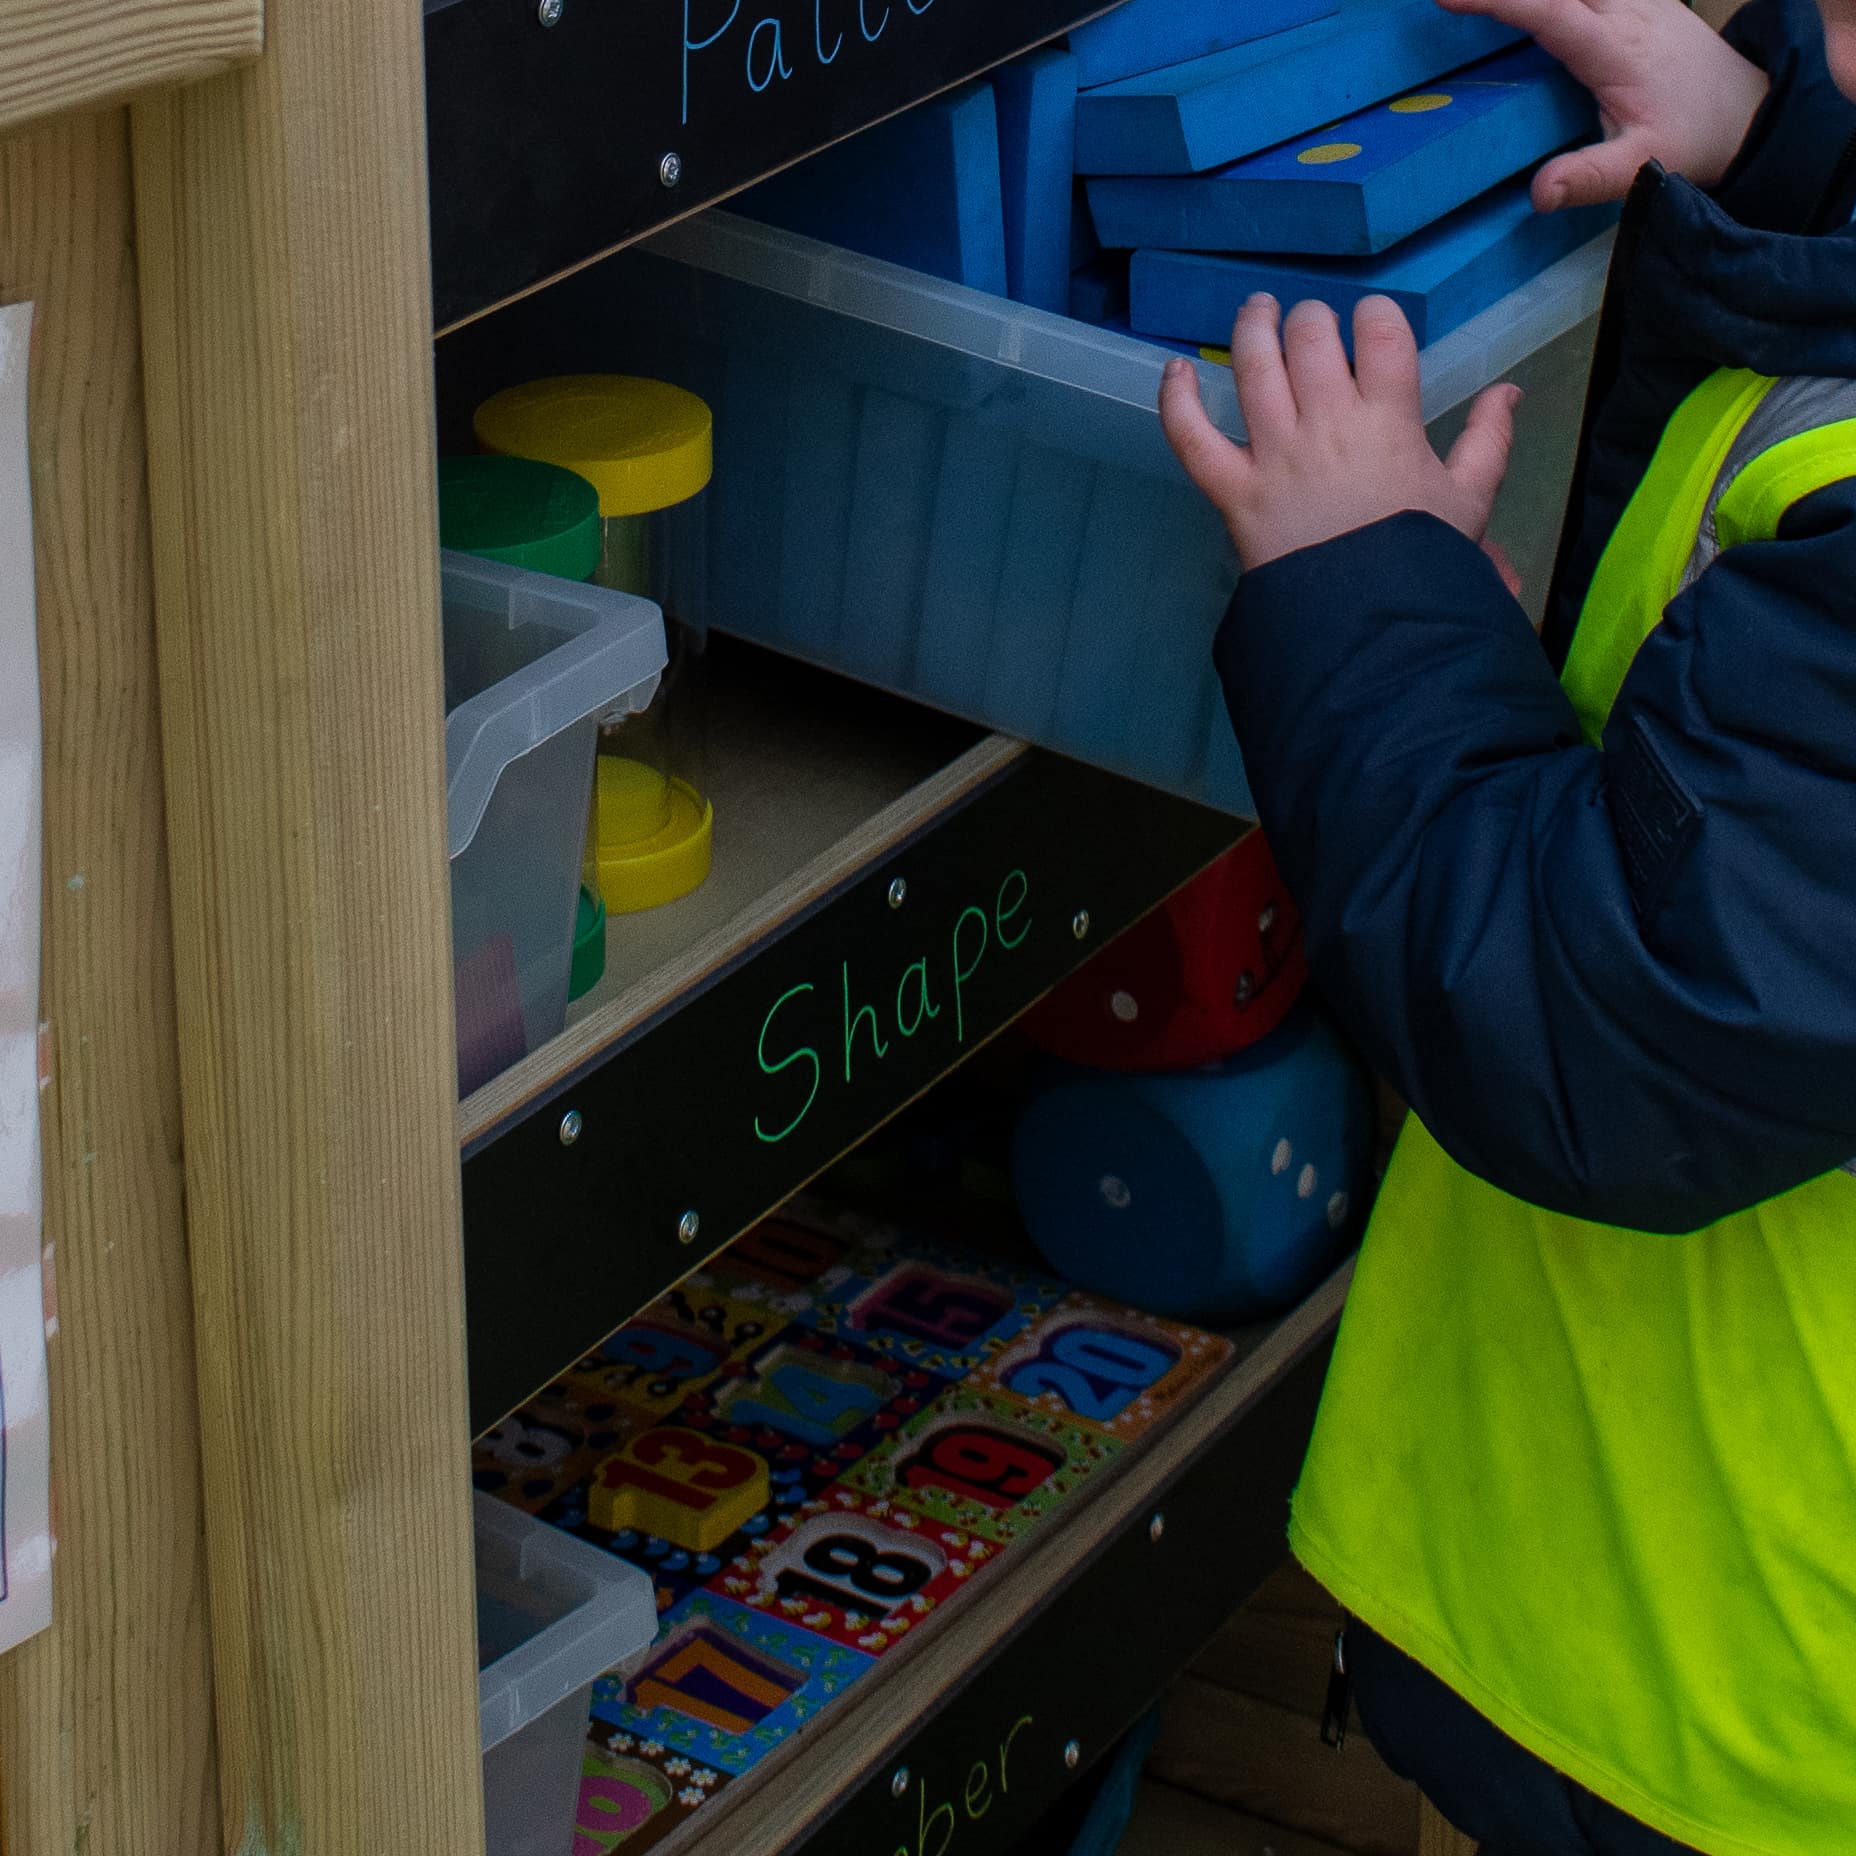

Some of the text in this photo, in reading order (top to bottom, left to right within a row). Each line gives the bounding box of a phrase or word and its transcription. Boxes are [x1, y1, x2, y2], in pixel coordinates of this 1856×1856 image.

[754, 869, 1033, 1143] Shape
[729, 1363, 883, 1445] 14
[1008, 1326, 1175, 1423] 20
[603, 1427, 758, 1512] 13
[905, 1432, 1057, 1511] 19
[775, 1532, 933, 1621] 18
[634, 1637, 796, 1735] 17
